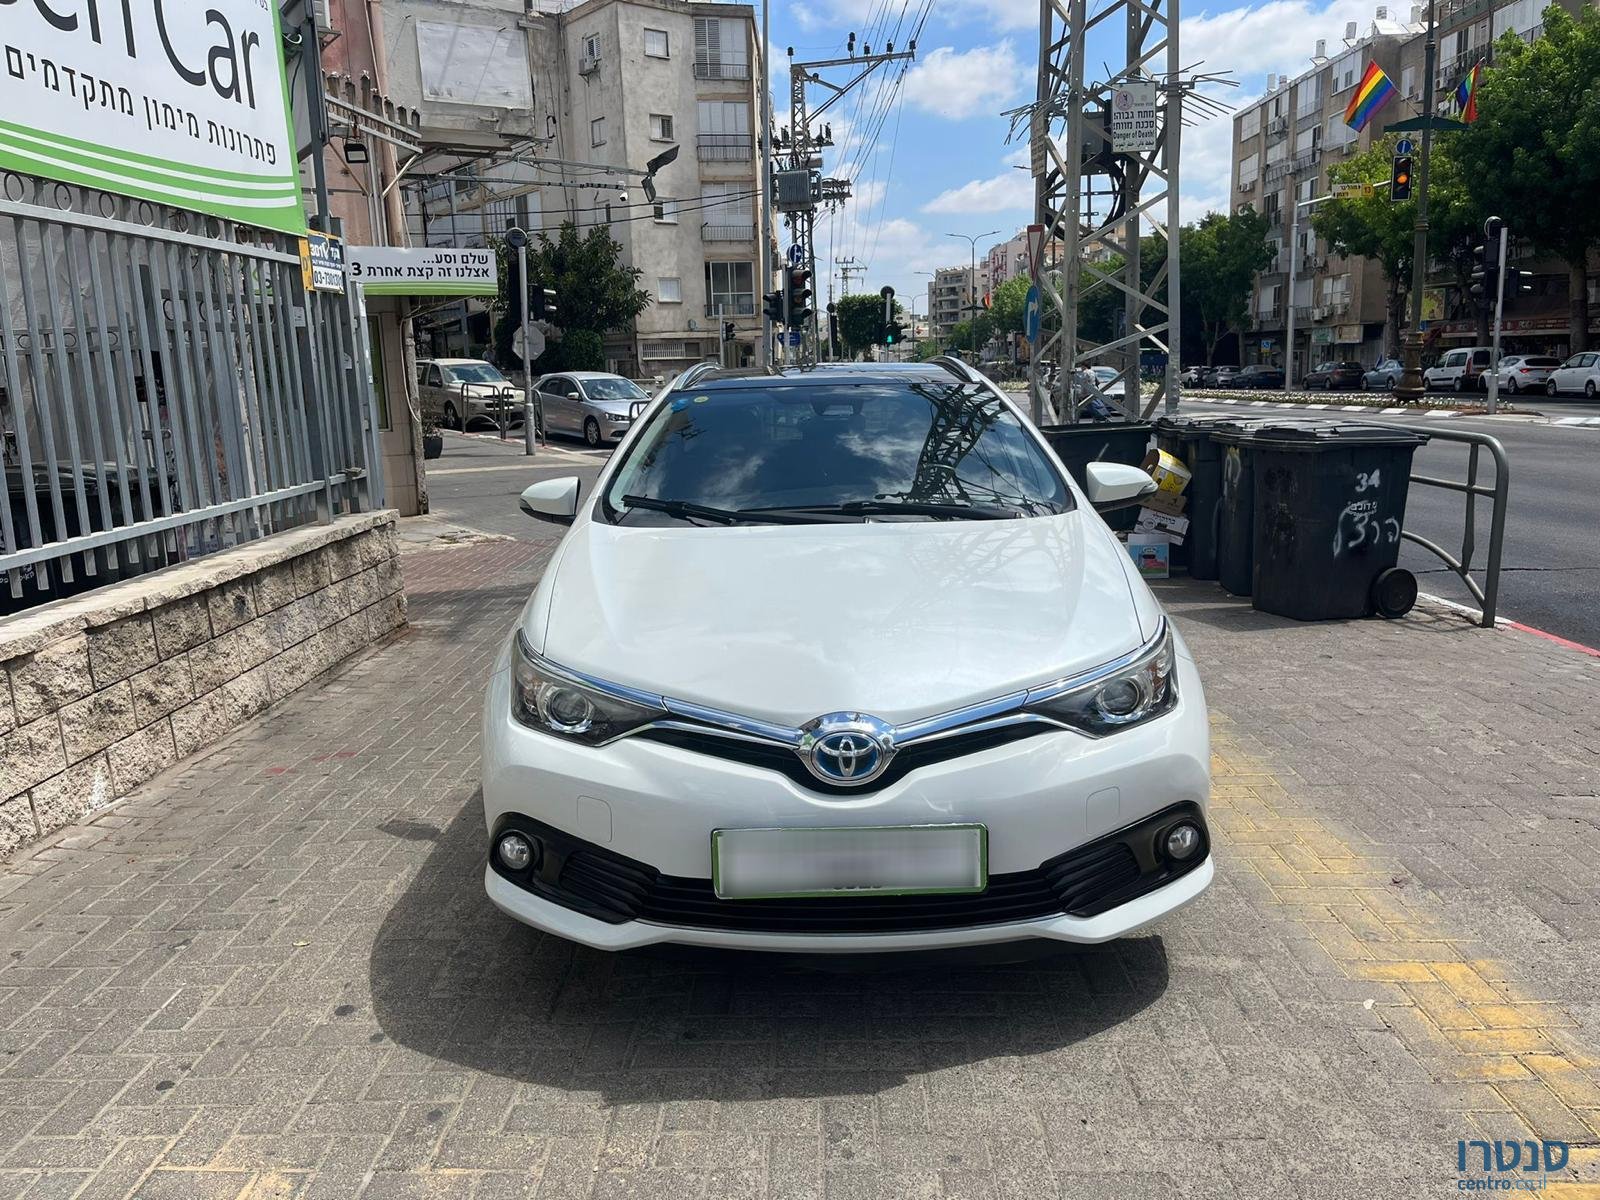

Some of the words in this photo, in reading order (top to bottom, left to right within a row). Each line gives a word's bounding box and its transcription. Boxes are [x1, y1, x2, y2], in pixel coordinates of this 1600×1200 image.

[5, 44, 134, 116] מתקדמים
[143, 95, 200, 138] מימון
[207, 119, 276, 165] פתרונות
[461, 252, 488, 265] שלם
[366, 266, 403, 277] אחרת
[407, 266, 434, 280] קצת
[438, 266, 452, 278] זה
[455, 265, 490, 278] אצלנו
[1355, 468, 1380, 492] 34
